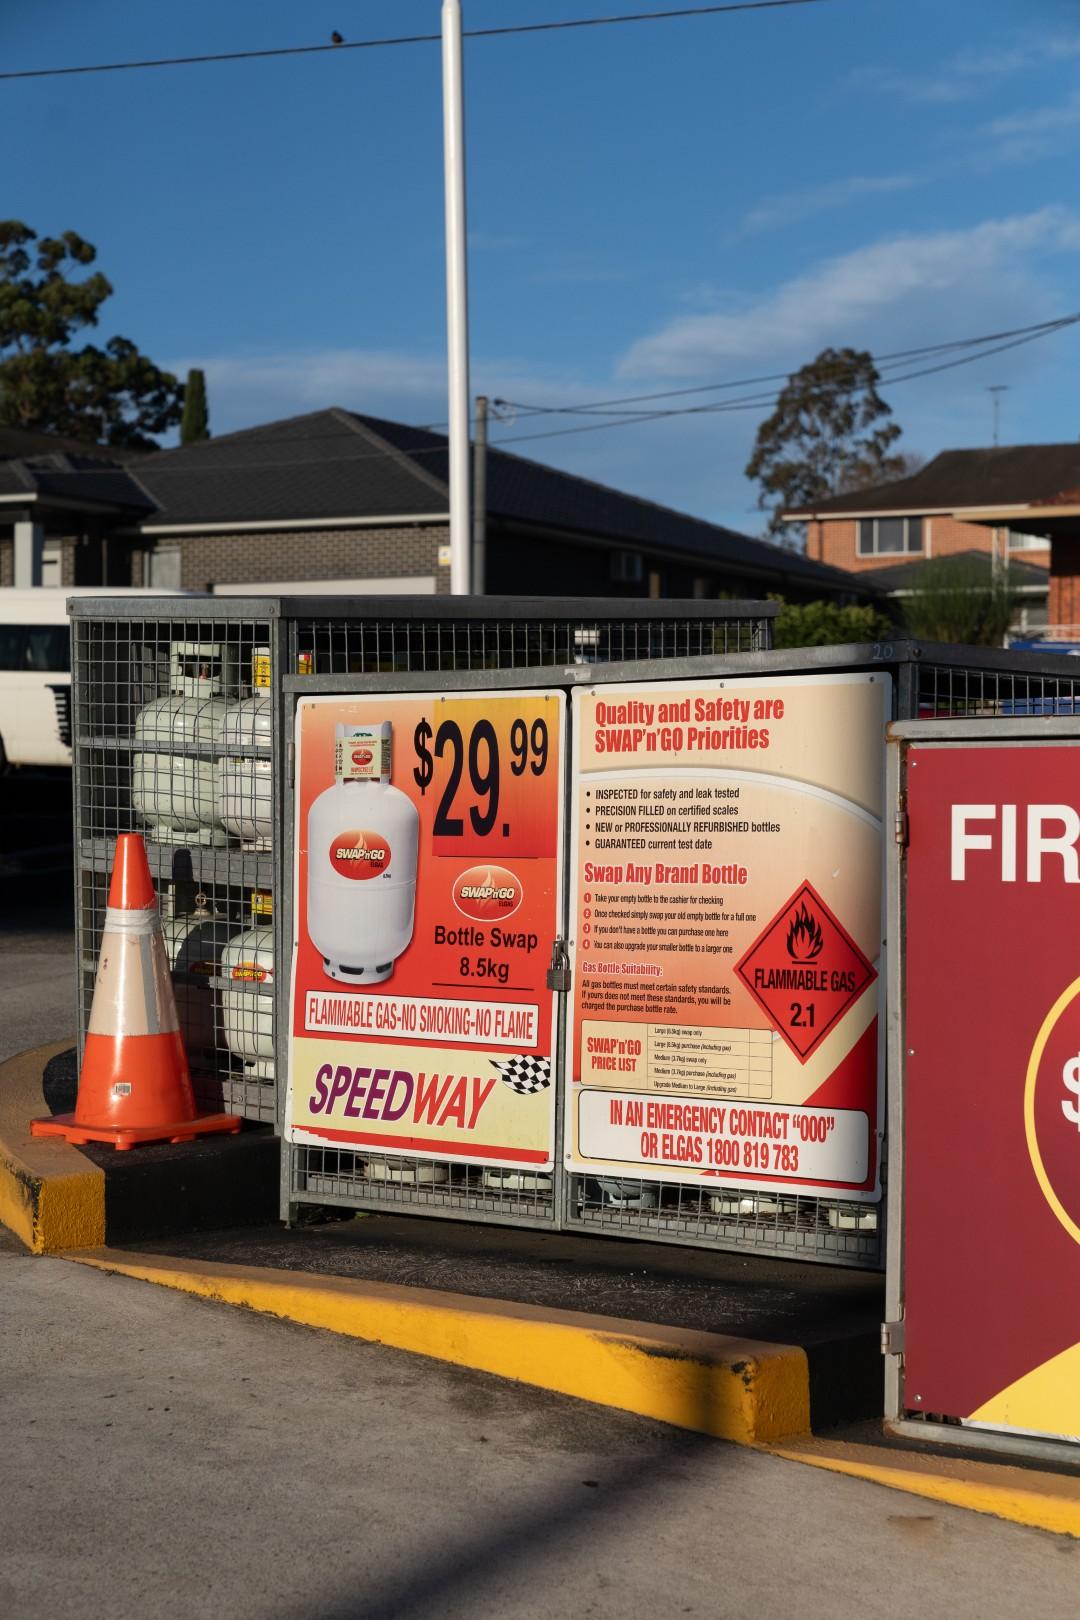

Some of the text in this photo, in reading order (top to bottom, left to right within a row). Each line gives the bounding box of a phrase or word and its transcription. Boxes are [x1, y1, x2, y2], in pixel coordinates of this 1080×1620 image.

[595, 698, 784, 727] Quality and Safety are
[595, 725, 769, 753] SWAP'n'GO Priorities
[595, 788, 740, 800] INSPECTED for safety and leak tested
[595, 805, 739, 816] PRECISION FILLED on certified scales
[595, 821, 780, 833] NEW or PROFESSIONALLY REFURBISHED bottles
[595, 838, 712, 849] GUARANTEED current test date
[584, 862, 747, 885] Swap Any Brand Bottle
[594, 894, 607, 902] Take
[608, 895, 619, 904] your
[620, 895, 636, 904] empty
[637, 895, 652, 903] bottle
[653, 895, 659, 903] to
[660, 895, 668, 903] the
[669, 896, 689, 904] cashier
[698, 896, 723, 906] checking
[594, 909, 607, 918] Once
[609, 910, 630, 918] checked
[631, 910, 648, 920] simply
[687, 912, 703, 922] empty
[704, 912, 720, 920] bottle
[721, 912, 729, 920] for
[735, 912, 744, 921] full
[434, 925, 538, 953] Bottle Swap
[594, 925, 598, 933] If
[598, 926, 608, 935] you
[609, 925, 623, 933] don't
[624, 926, 636, 934] have
[641, 926, 656, 935] bottle
[657, 928, 667, 936] you
[678, 928, 704, 937] purchase
[716, 928, 729, 936] here
[613, 941, 624, 949] also
[625, 942, 645, 951] upgrade
[646, 944, 658, 952] your
[659, 943, 678, 951] smaller
[679, 943, 694, 952] bottle
[695, 944, 700, 952] to
[706, 944, 722, 954] larger
[460, 957, 509, 983] 8.5kg
[582, 962, 663, 976] Gas Bottle Suitability:
[582, 979, 590, 988] All
[603, 981, 622, 989] bottles
[623, 981, 639, 990] must
[640, 982, 655, 990] meet
[656, 984, 677, 992] certain
[678, 984, 697, 994] safety
[698, 985, 731, 994] standards.
[754, 968, 856, 992] FLAMMABLE GAS
[581, 990, 587, 998] If
[587, 992, 603, 1000] yours
[605, 992, 618, 1000] does
[647, 994, 664, 1002] these
[664, 995, 696, 1005] standards,
[698, 998, 709, 1006] you
[710, 997, 722, 1005] will
[723, 997, 731, 1005] be
[581, 1001, 678, 1014] charged the purchase bottle rate.
[790, 1003, 815, 1027] 2.1
[309, 997, 373, 1028] FLAMMABLE
[495, 1009, 533, 1040] FLAME
[587, 1036, 642, 1056] SWAP'n'GO
[591, 1055, 637, 1072] PRICE LIST
[309, 1063, 497, 1130] SPEEDWAY
[609, 1099, 622, 1125] IN
[625, 1100, 643, 1127] AN
[646, 1102, 726, 1134] EMERGENCY
[729, 1109, 789, 1139] CONTACT
[641, 1131, 799, 1171] OR ELGAS 1800 819 783
